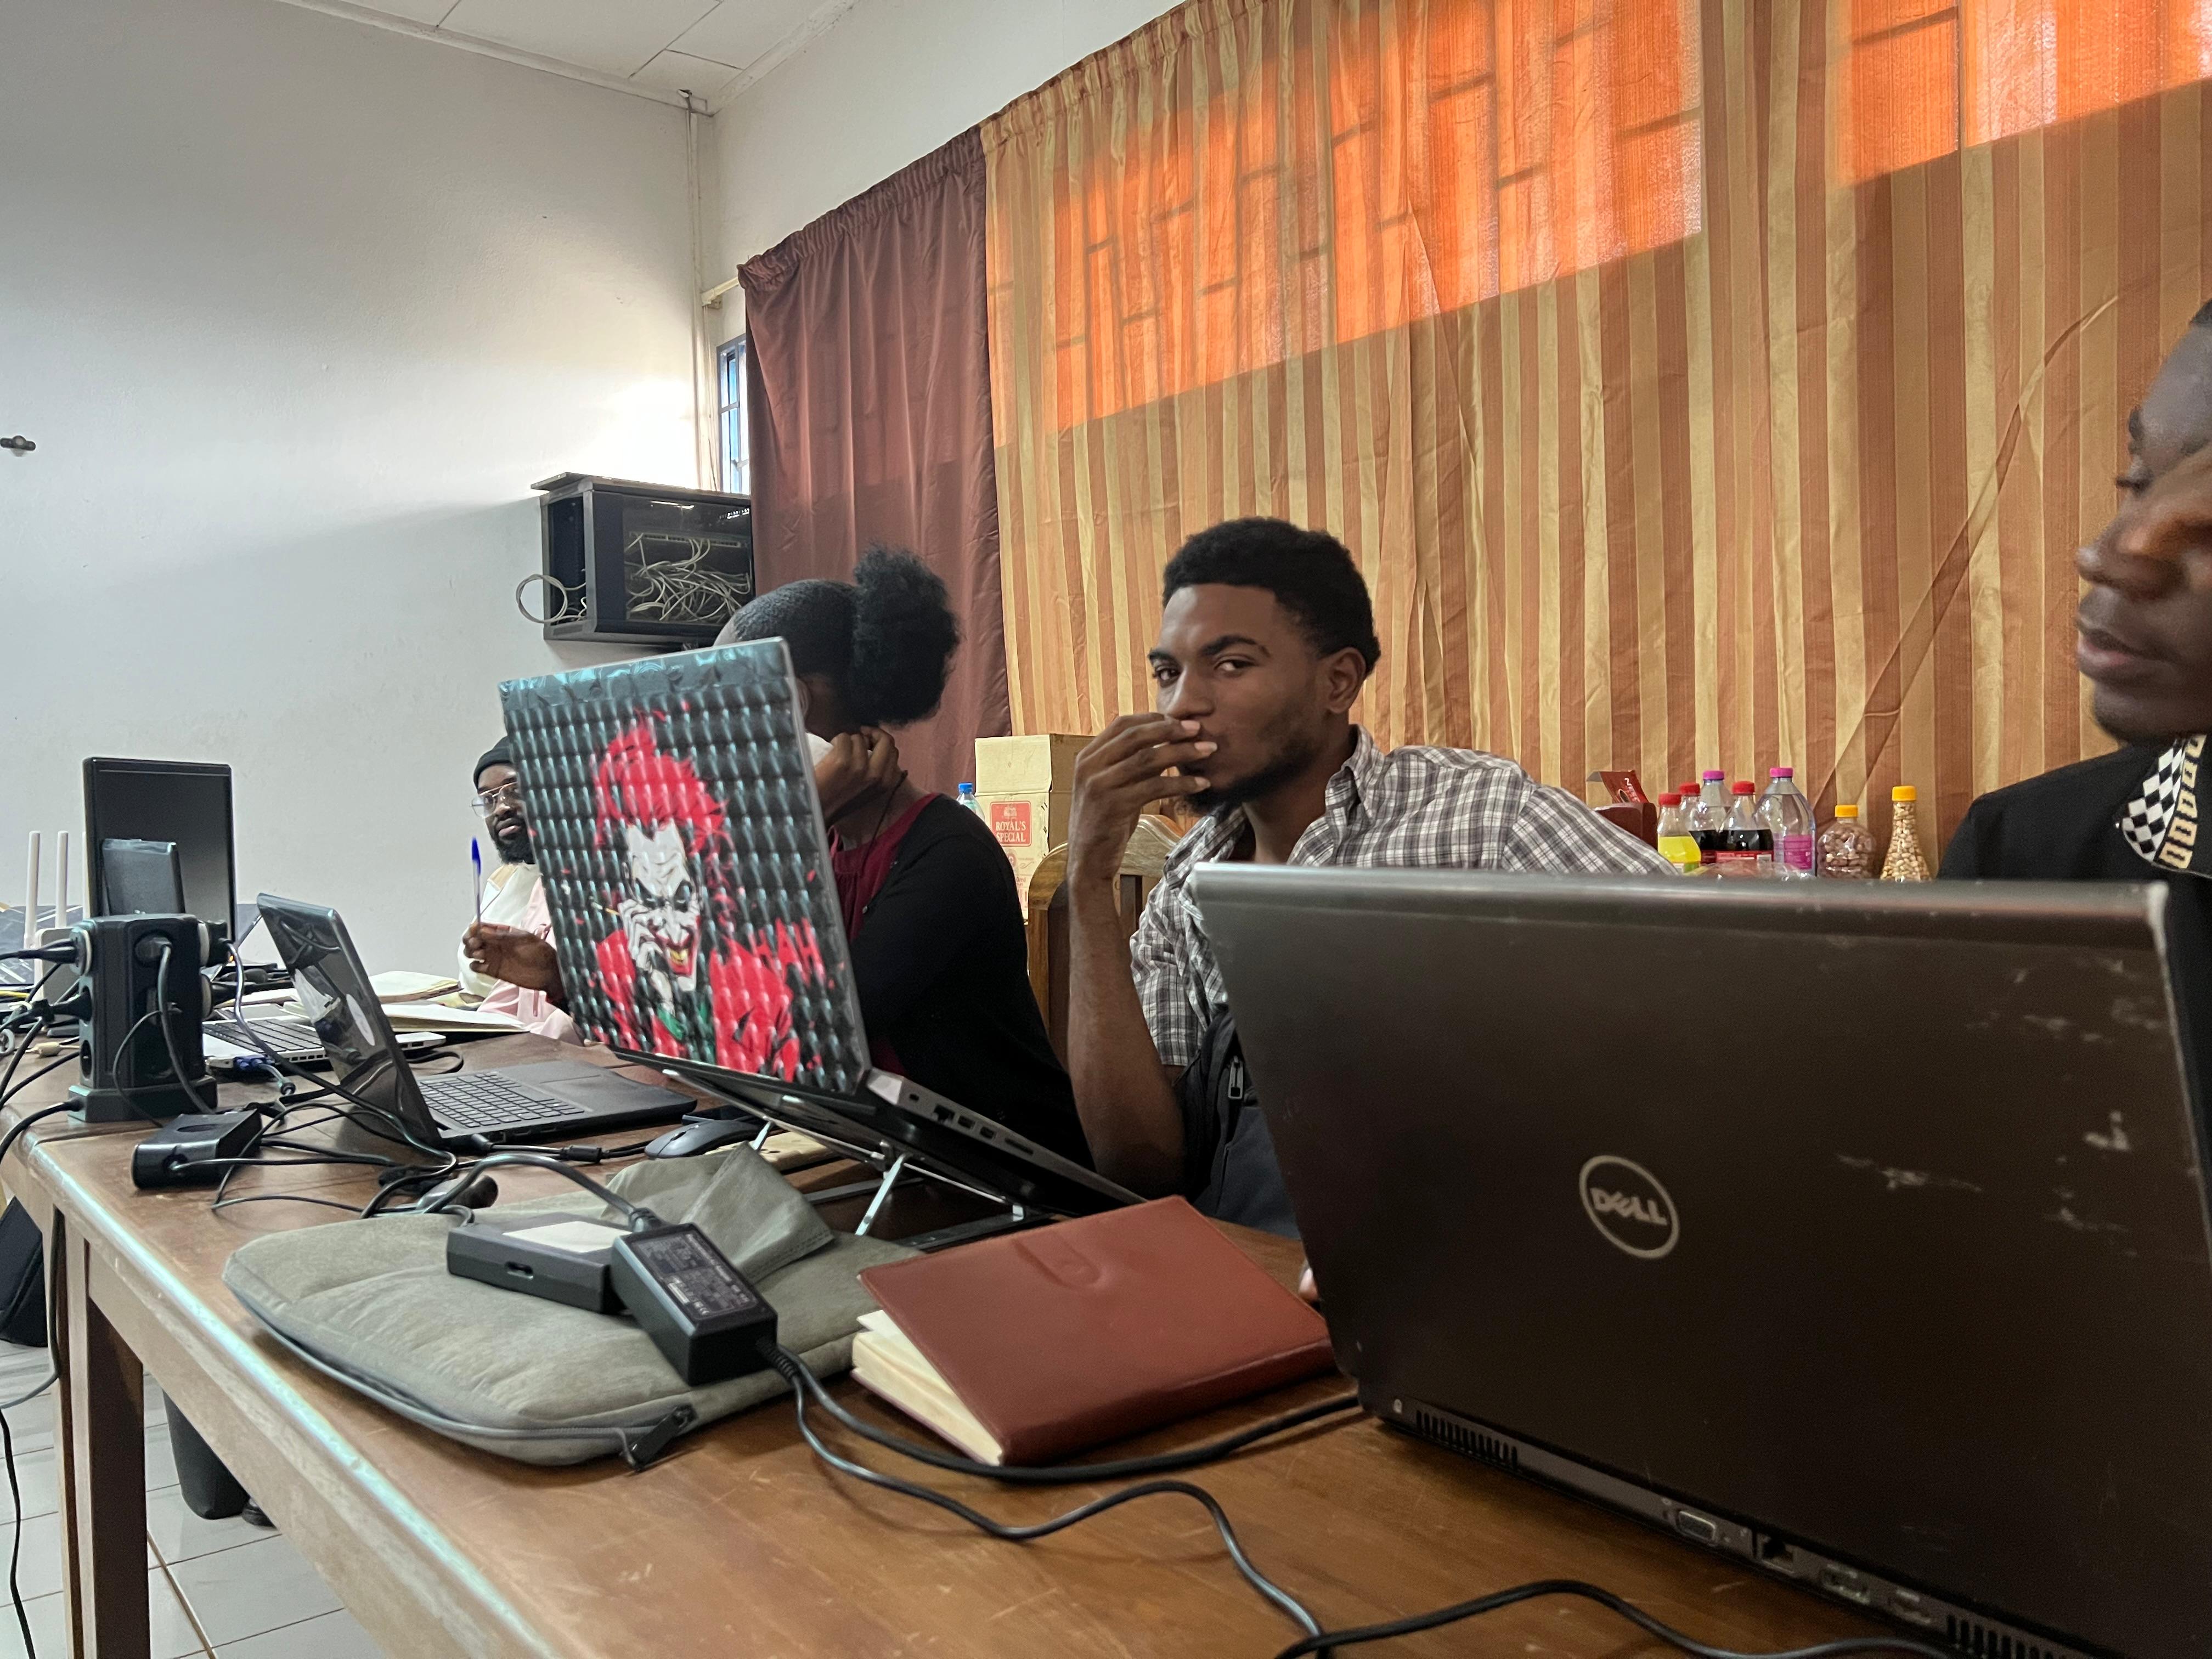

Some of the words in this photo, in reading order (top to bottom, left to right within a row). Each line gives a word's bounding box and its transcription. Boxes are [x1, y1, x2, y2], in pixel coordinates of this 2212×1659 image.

[995, 821, 1026, 831] ROYAL'S
[996, 832, 1026, 842] SPECIAL
[1590, 1187, 1667, 1226] DELL
